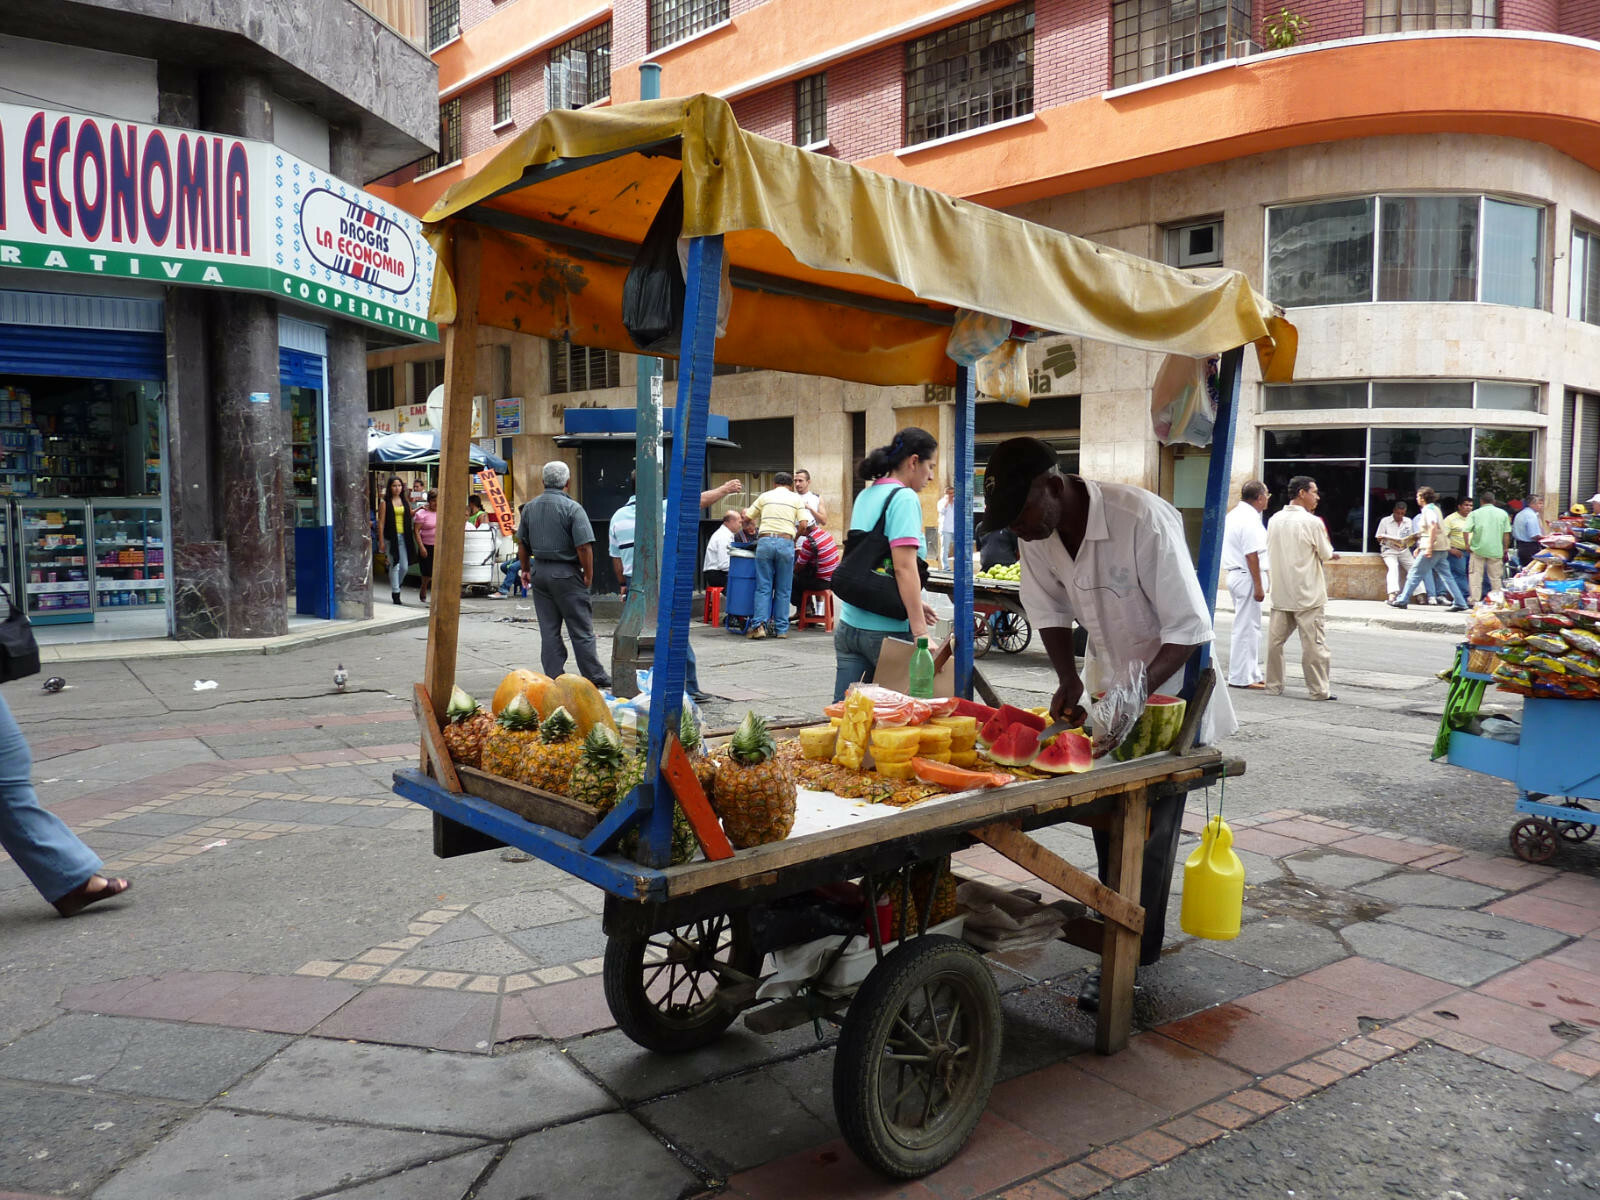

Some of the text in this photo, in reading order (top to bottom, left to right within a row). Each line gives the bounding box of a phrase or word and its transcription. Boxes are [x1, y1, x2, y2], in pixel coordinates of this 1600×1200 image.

[23, 112, 250, 257] ECONOMIA
[316, 226, 405, 278] LA ECONOMIA
[340, 217, 389, 252] DROGAS
[1, 246, 223, 283] RATIVA
[283, 278, 427, 335] COOPERATIVA
[481, 472, 513, 531] MINUTOS
